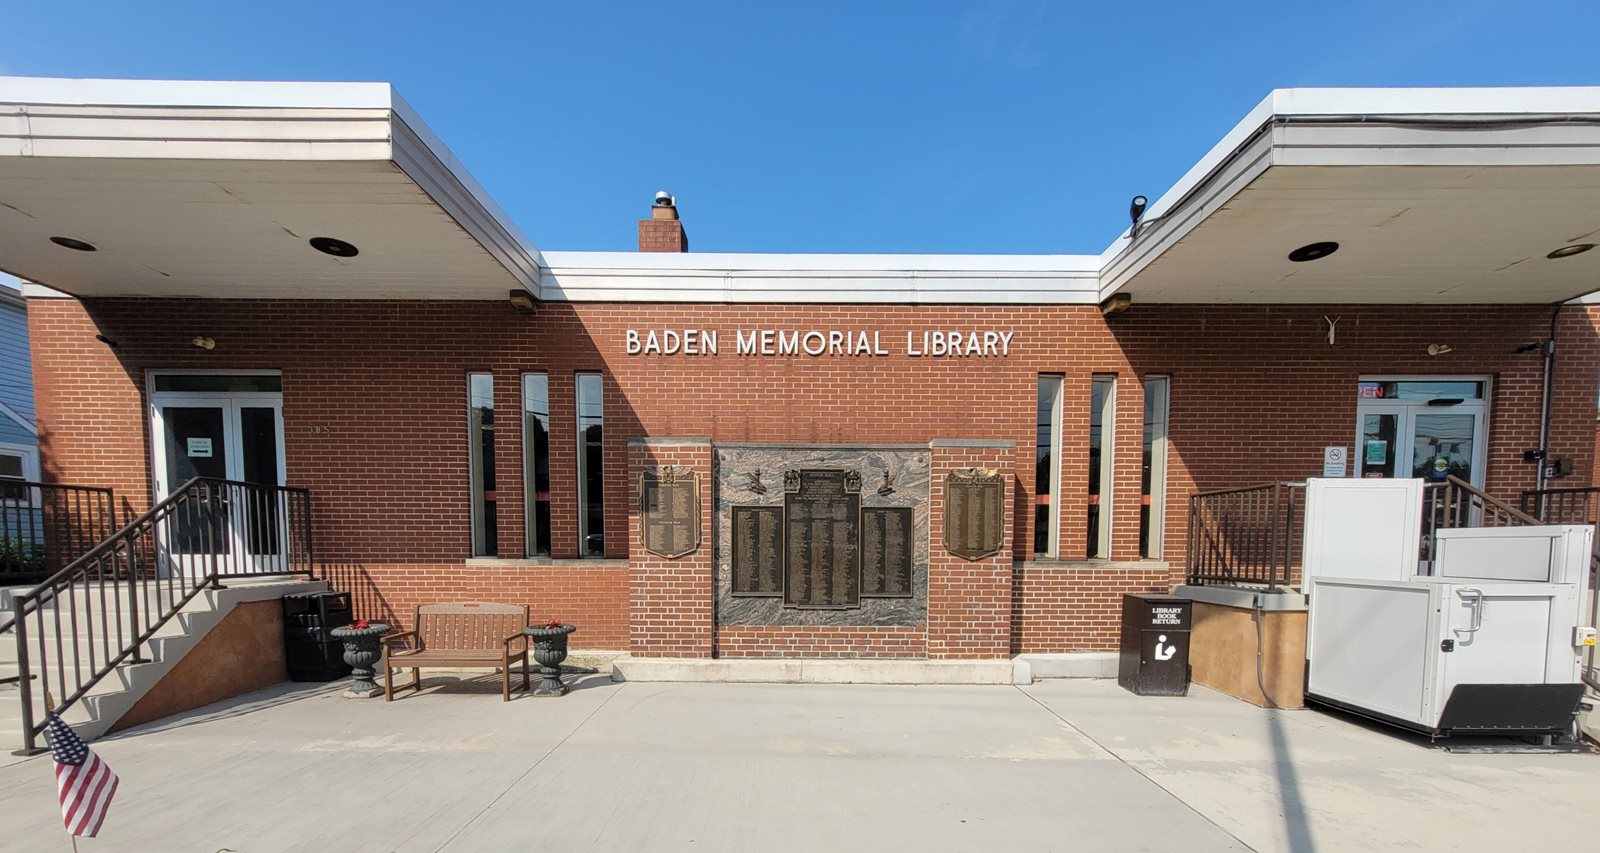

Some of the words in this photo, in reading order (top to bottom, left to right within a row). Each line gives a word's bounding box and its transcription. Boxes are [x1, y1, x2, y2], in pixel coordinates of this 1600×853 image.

[626, 329, 718, 355] BADEN
[736, 330, 889, 356] MEMORIAL
[907, 331, 1013, 356] LIBRARY
